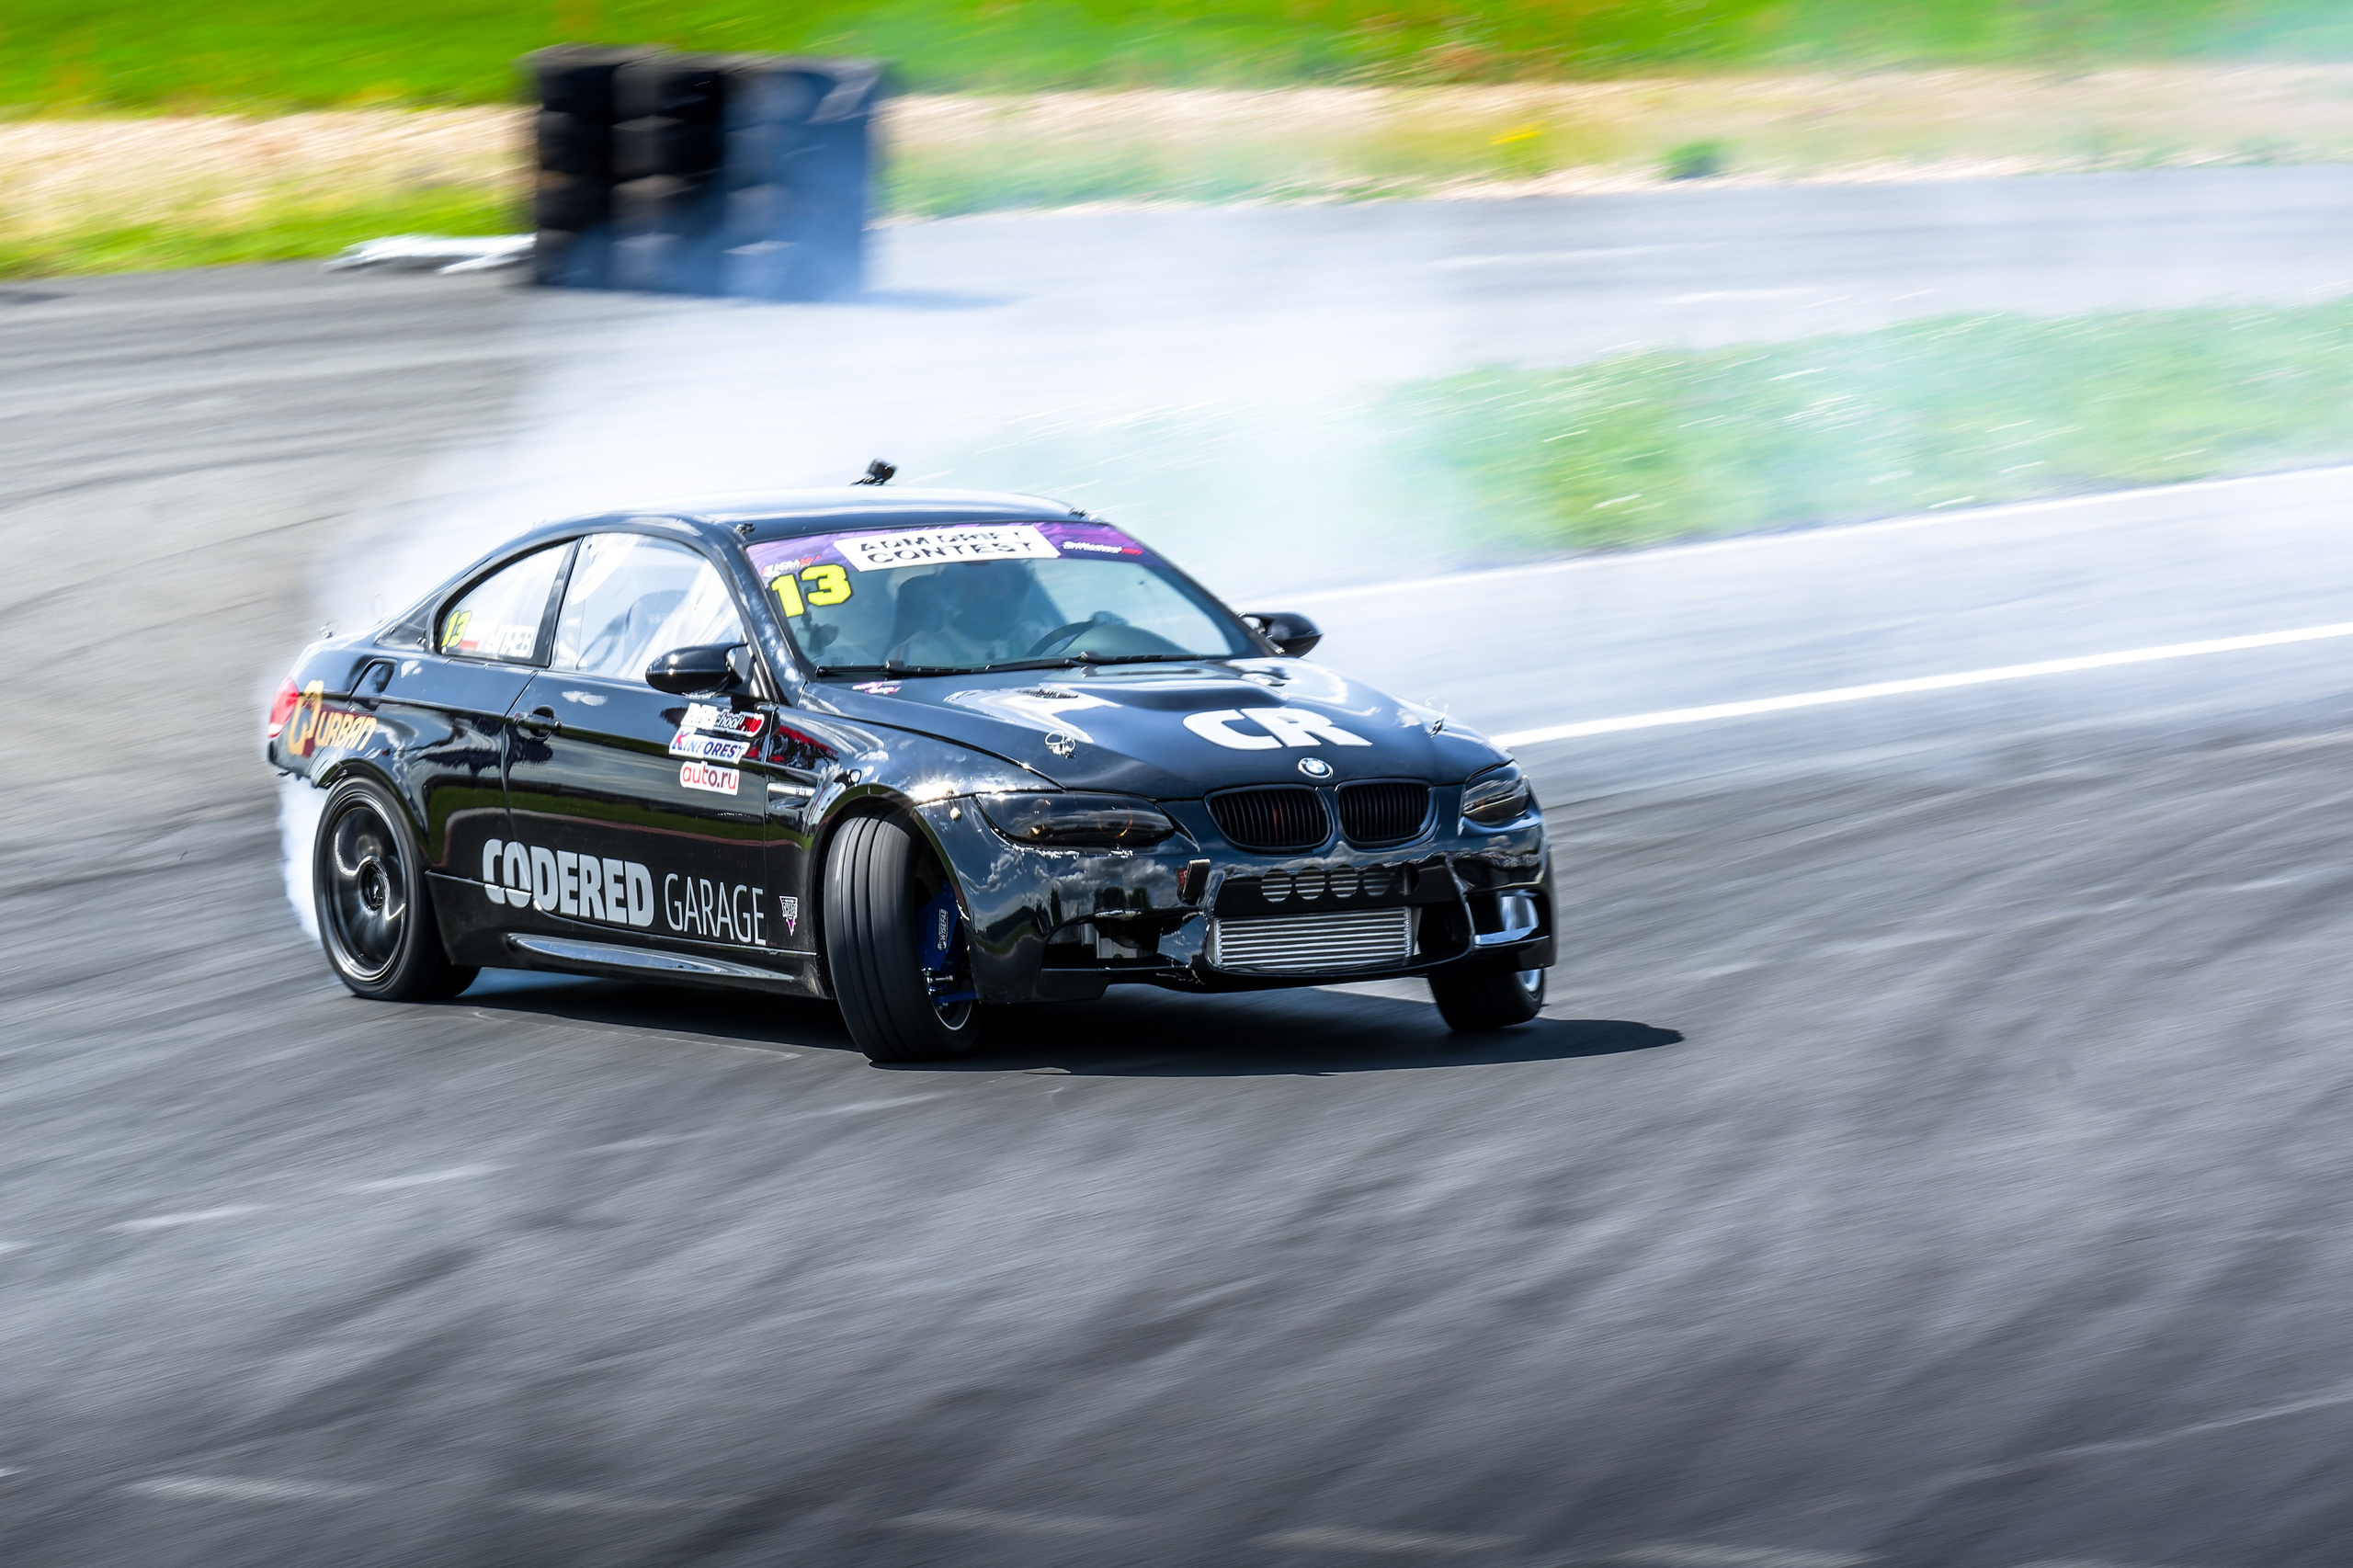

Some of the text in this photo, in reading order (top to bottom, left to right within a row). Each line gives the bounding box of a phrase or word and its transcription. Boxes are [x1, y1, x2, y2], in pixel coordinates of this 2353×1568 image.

[867, 541, 1032, 563] CONTEST
[771, 563, 853, 619] 13
[441, 610, 472, 648] 13
[671, 730, 747, 759] KINFOREST
[1183, 707, 1373, 750] CR
[682, 763, 738, 790] auto.ru
[482, 838, 767, 947] CODERED GARAGE
